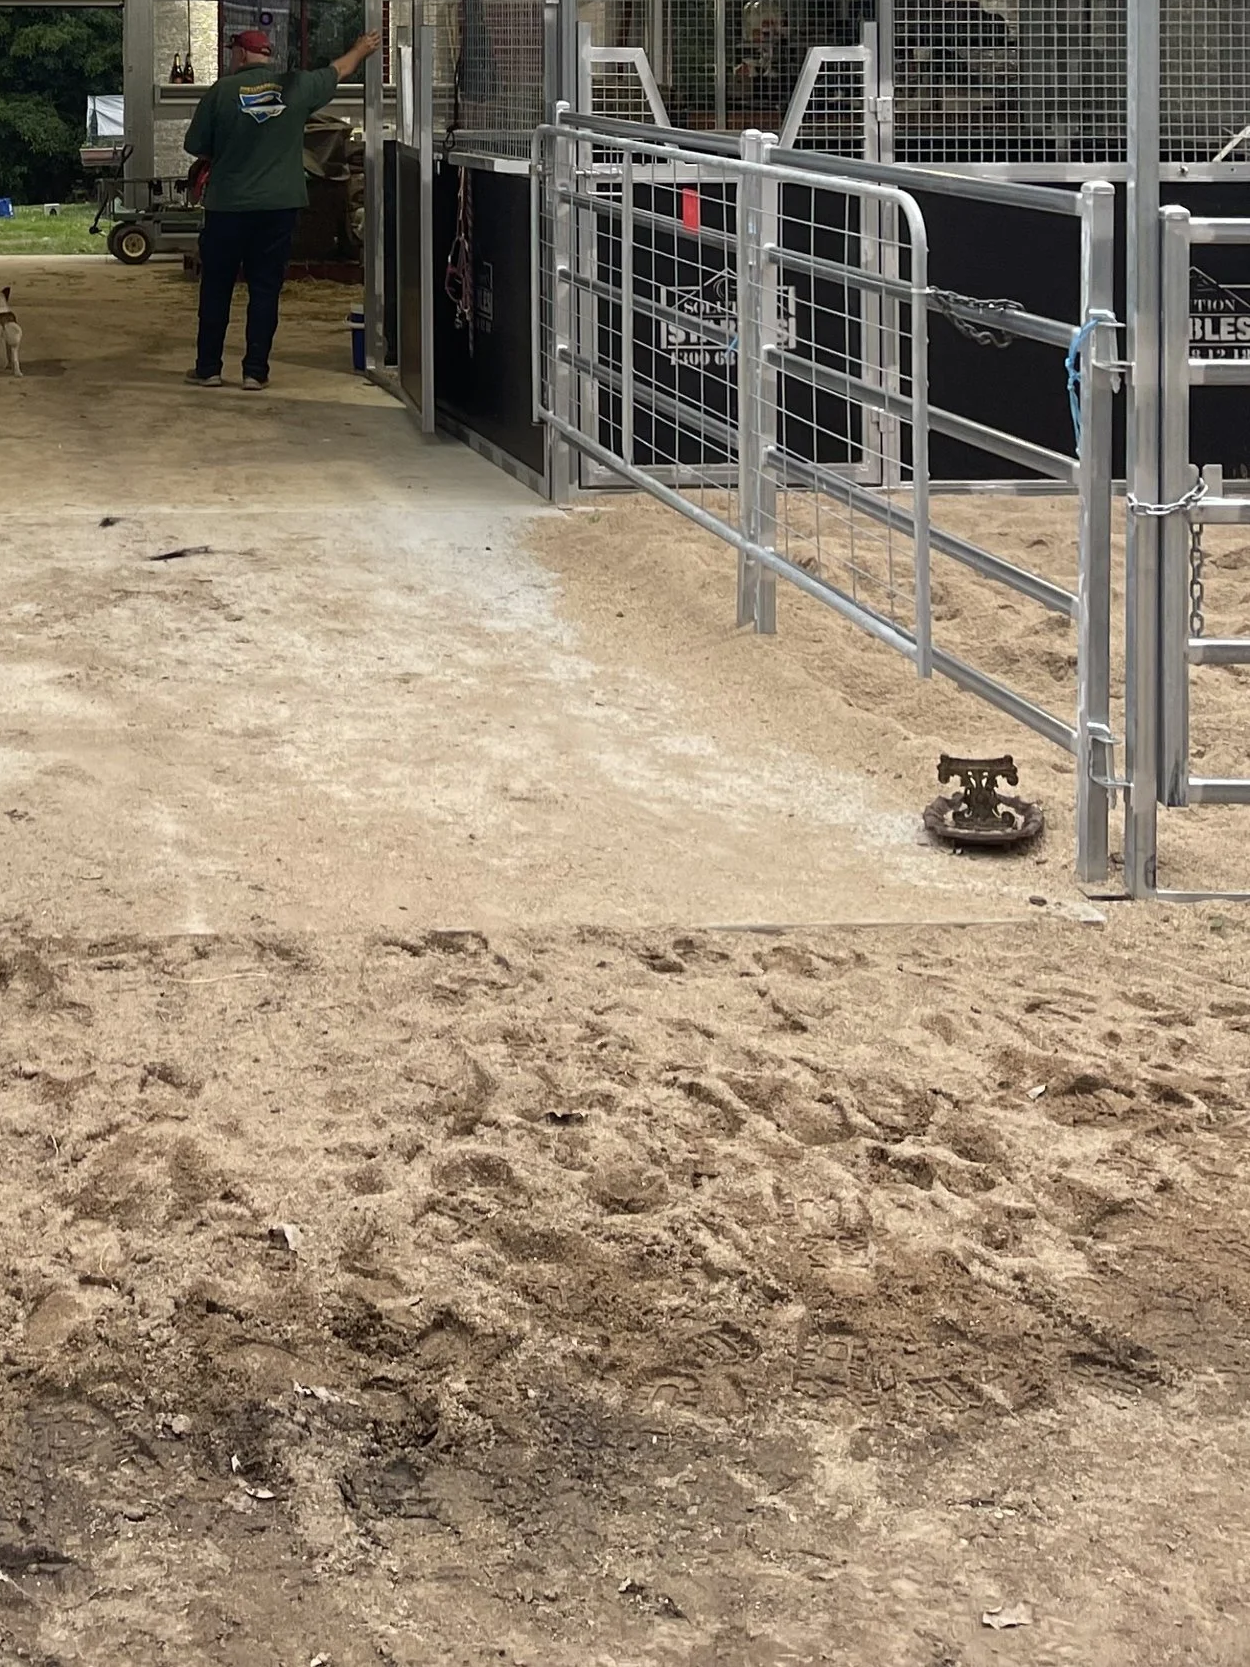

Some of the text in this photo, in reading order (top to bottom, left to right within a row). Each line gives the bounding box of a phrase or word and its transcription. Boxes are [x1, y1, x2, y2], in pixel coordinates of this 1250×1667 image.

[683, 301, 737, 314] SOLUT
[1194, 299, 1236, 312] TION
[1189, 316, 1250, 341] BLES
[670, 351, 710, 365] 1300
